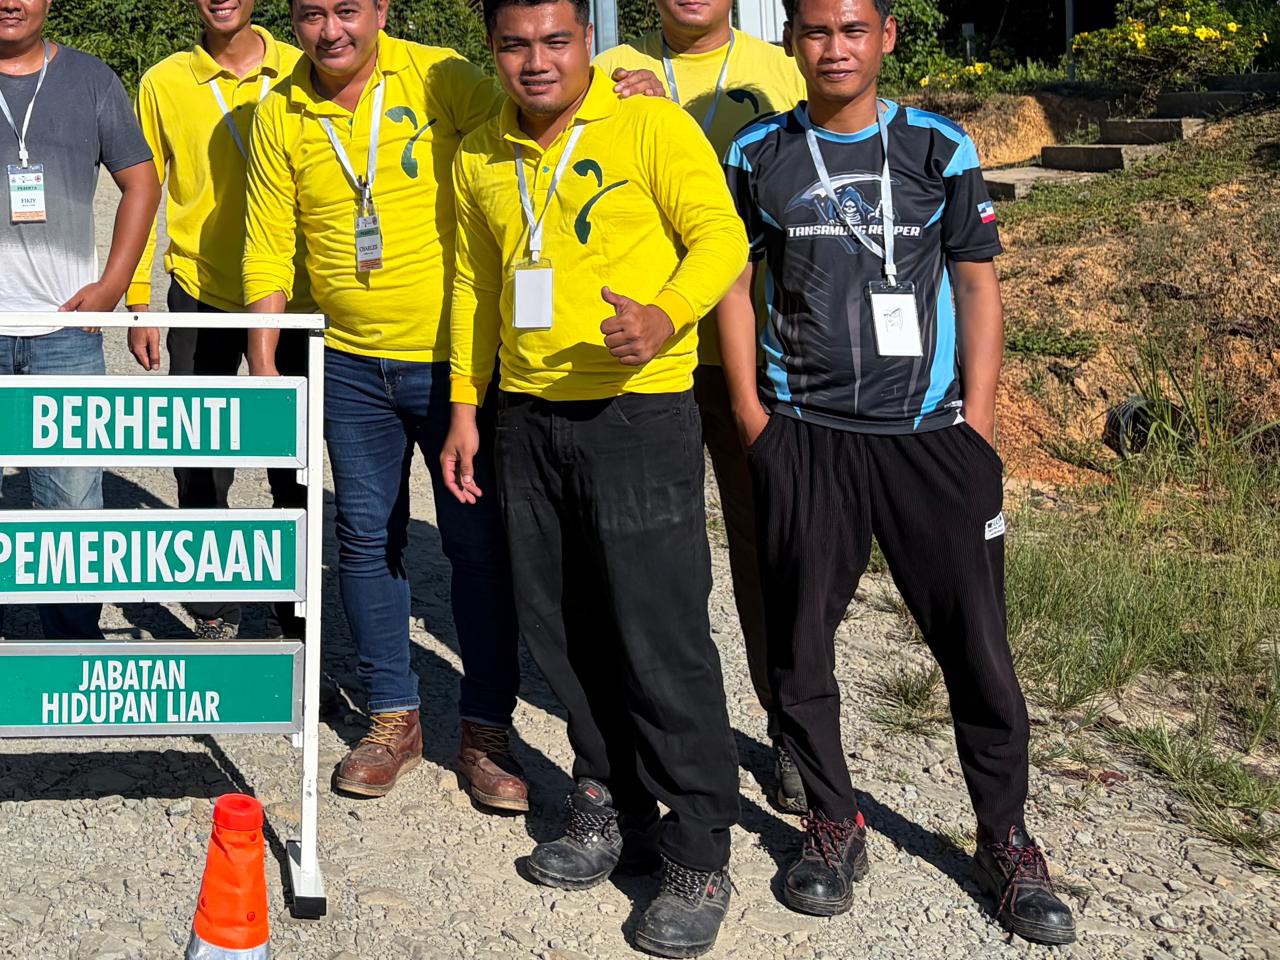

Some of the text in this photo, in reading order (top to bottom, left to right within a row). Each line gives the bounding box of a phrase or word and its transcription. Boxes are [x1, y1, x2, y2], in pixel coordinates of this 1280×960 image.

[868, 224, 921, 237] REPER
[32, 395, 241, 450] BERHENTI
[78, 659, 186, 691] JABATAN
[42, 691, 220, 724] HIDUPAN LIAR
